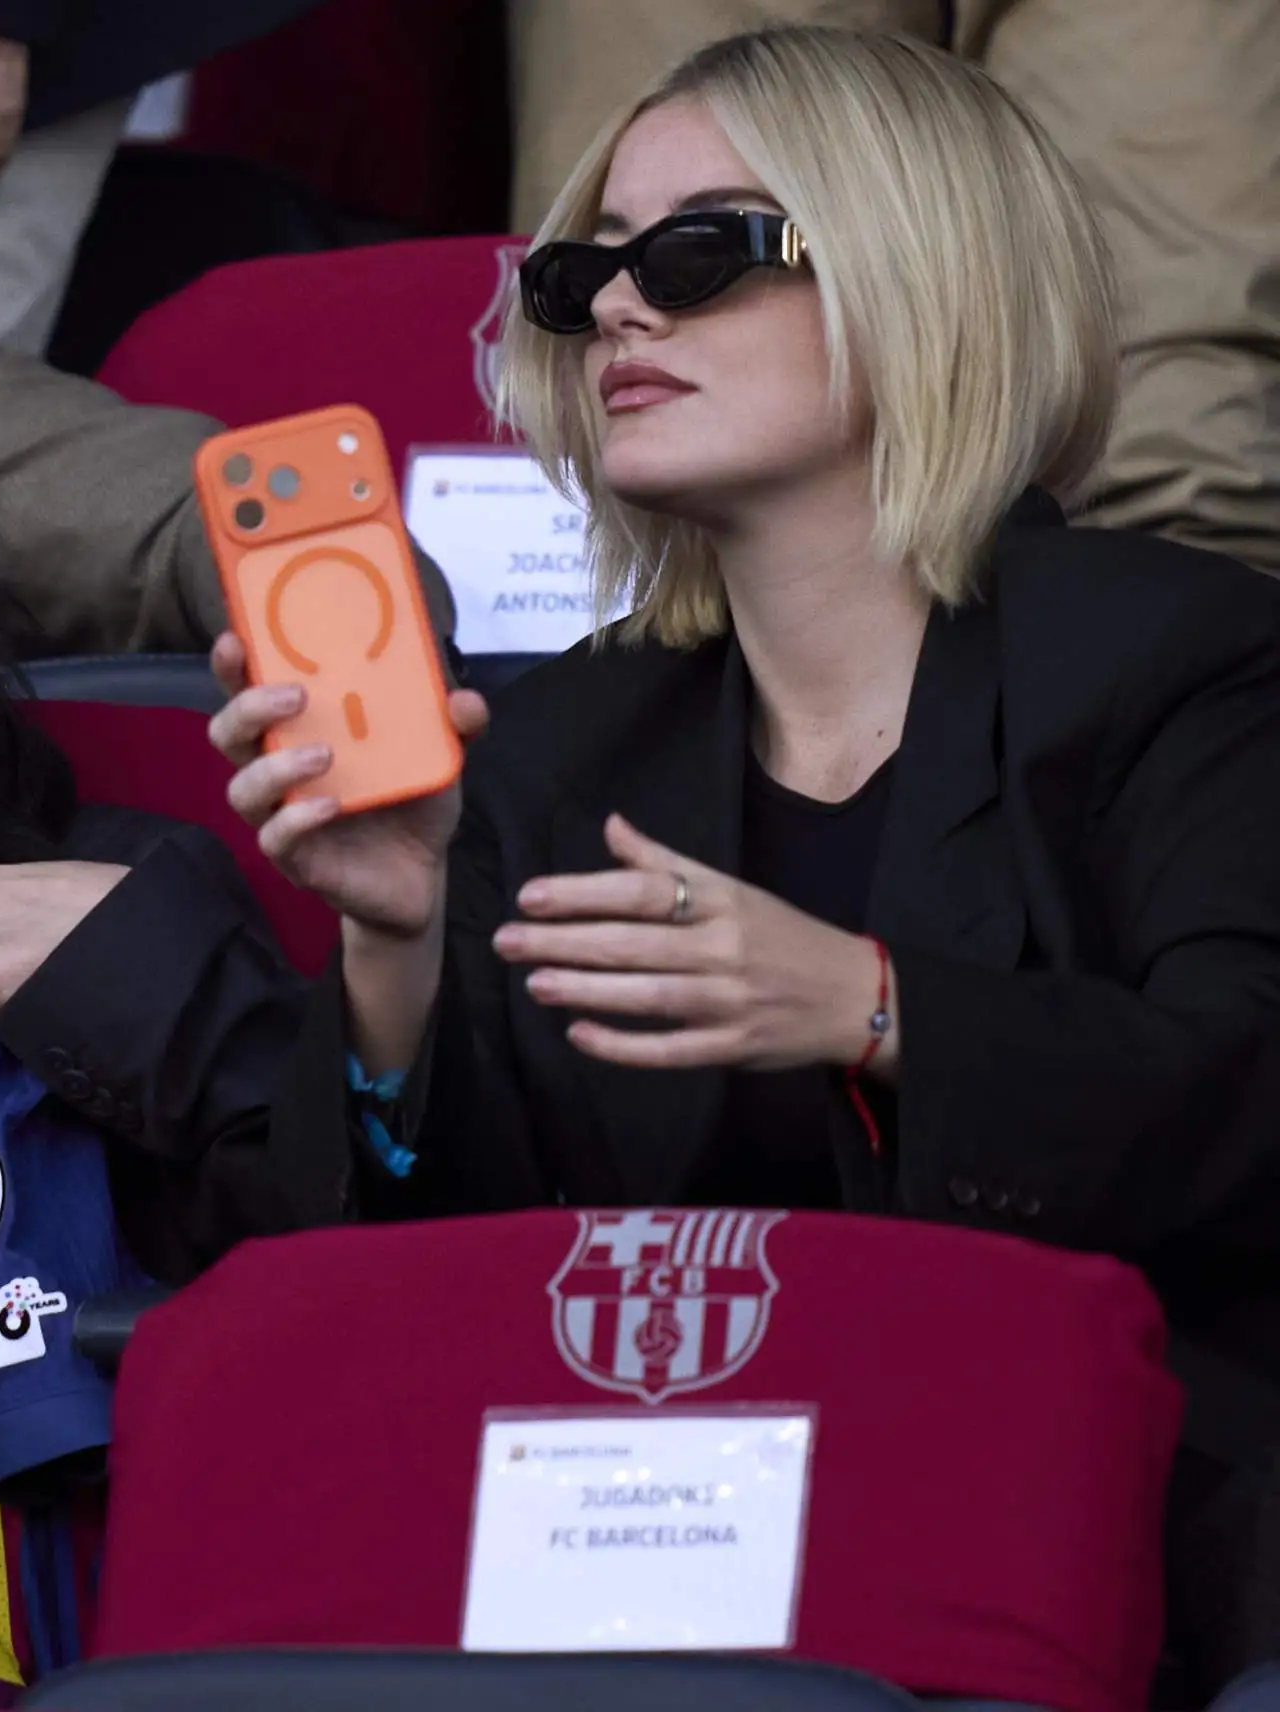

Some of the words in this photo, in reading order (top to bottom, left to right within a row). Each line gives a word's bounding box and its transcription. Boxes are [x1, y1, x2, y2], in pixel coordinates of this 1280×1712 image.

[507, 552, 589, 574] JOACH
[493, 592, 623, 614] ANTONS
[621, 1265, 706, 1297] FCB
[29, 1298, 60, 1310] YEARS
[550, 1526, 578, 1549] FC
[587, 1523, 738, 1549] BARCELONA
